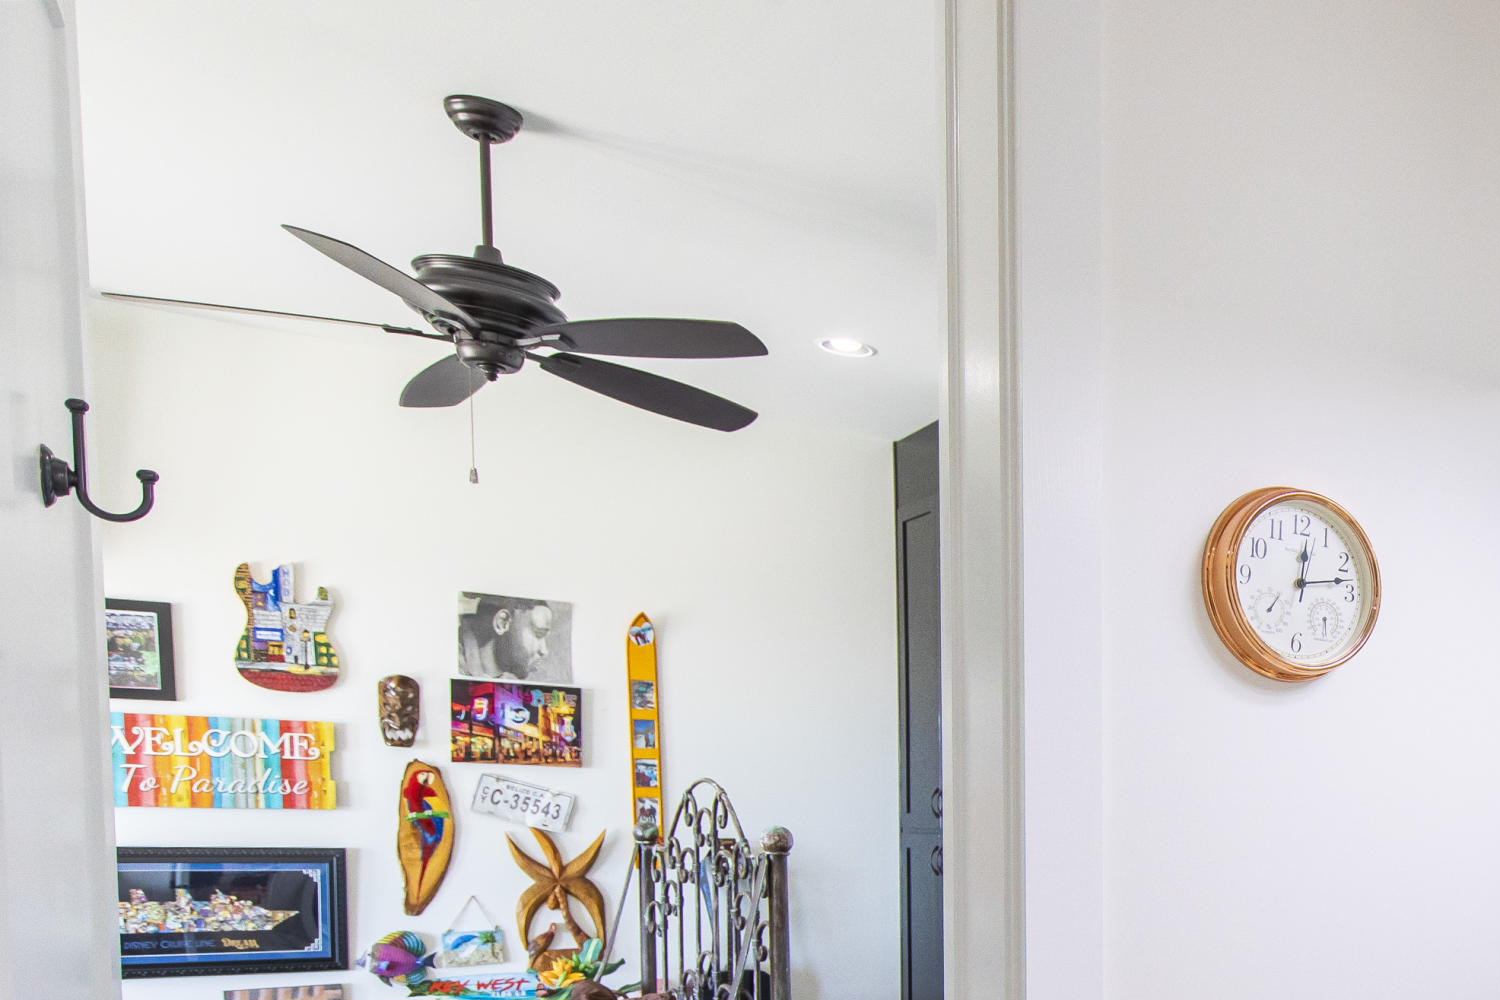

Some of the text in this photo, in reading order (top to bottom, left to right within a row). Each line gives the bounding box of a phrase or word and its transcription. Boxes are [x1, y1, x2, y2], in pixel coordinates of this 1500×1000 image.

[1269, 518, 1284, 540] 11
[1293, 514, 1311, 537] 12
[1250, 536, 1268, 560] 10
[1322, 528, 1329, 548] 1
[1338, 552, 1349, 573] 2
[1239, 564, 1252, 585] 9
[1344, 584, 1355, 603] 3
[1290, 632, 1302, 653] 6
[110, 725, 320, 760] WELCOME
[120, 763, 310, 796] To Paradise
[490, 788, 562, 820] C-35543
[429, 977, 530, 996] KEY WEST
